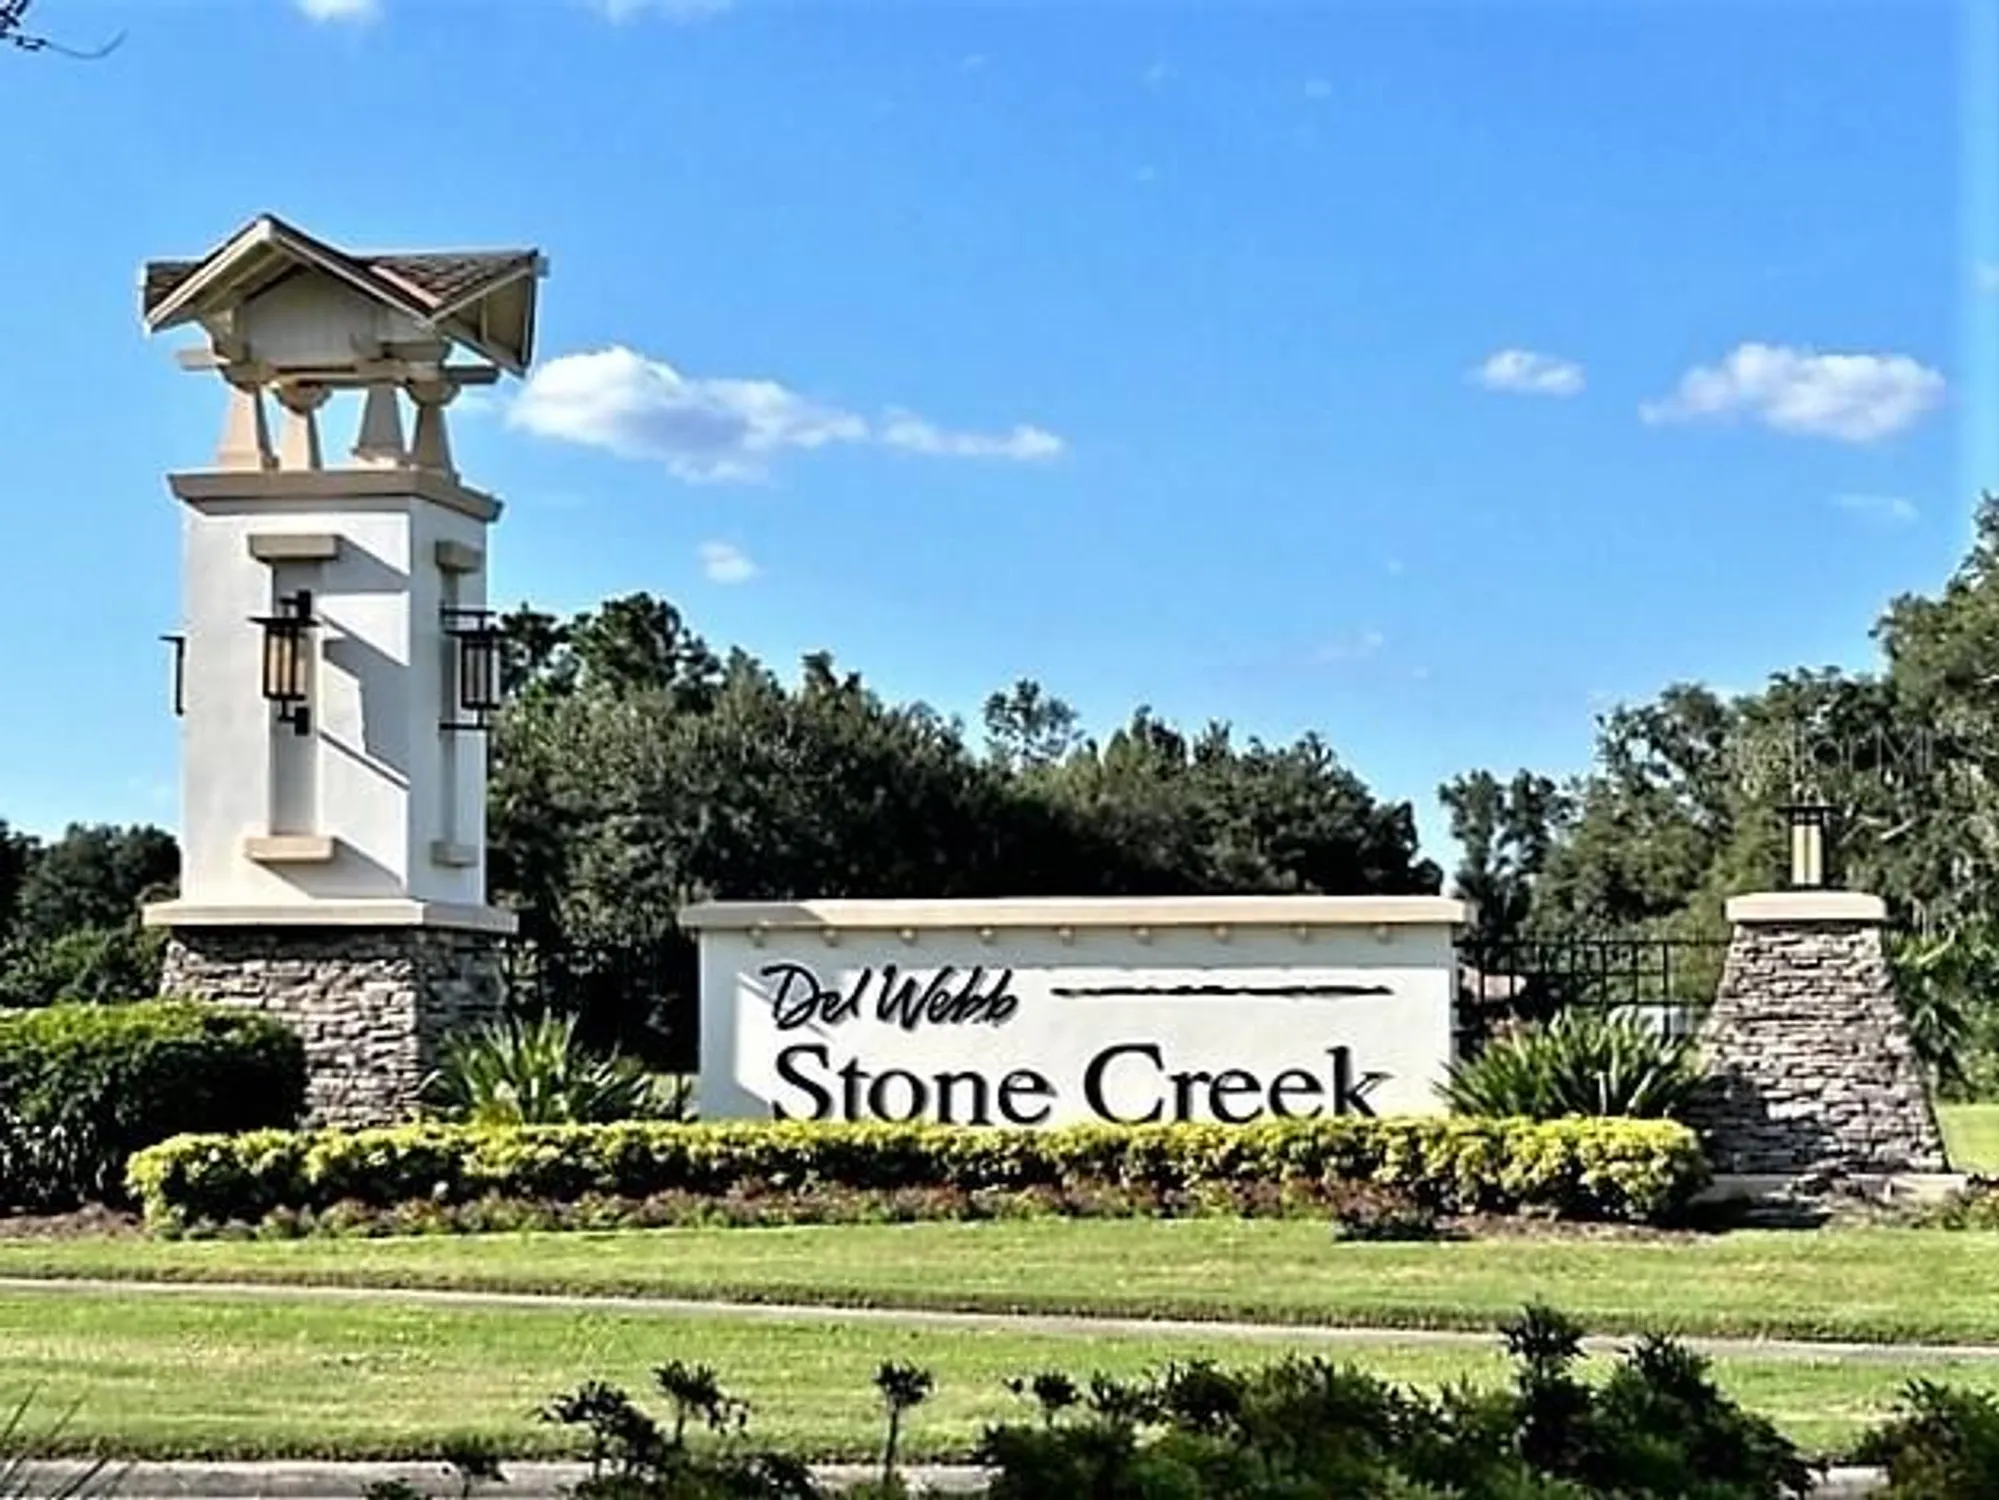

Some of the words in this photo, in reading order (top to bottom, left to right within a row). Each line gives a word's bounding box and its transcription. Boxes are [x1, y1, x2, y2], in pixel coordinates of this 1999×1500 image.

[761, 964, 872, 1030] Del
[876, 965, 1020, 1030] Webb
[773, 1044, 1057, 1125] Stone
[1083, 1043, 1394, 1125] Creek
